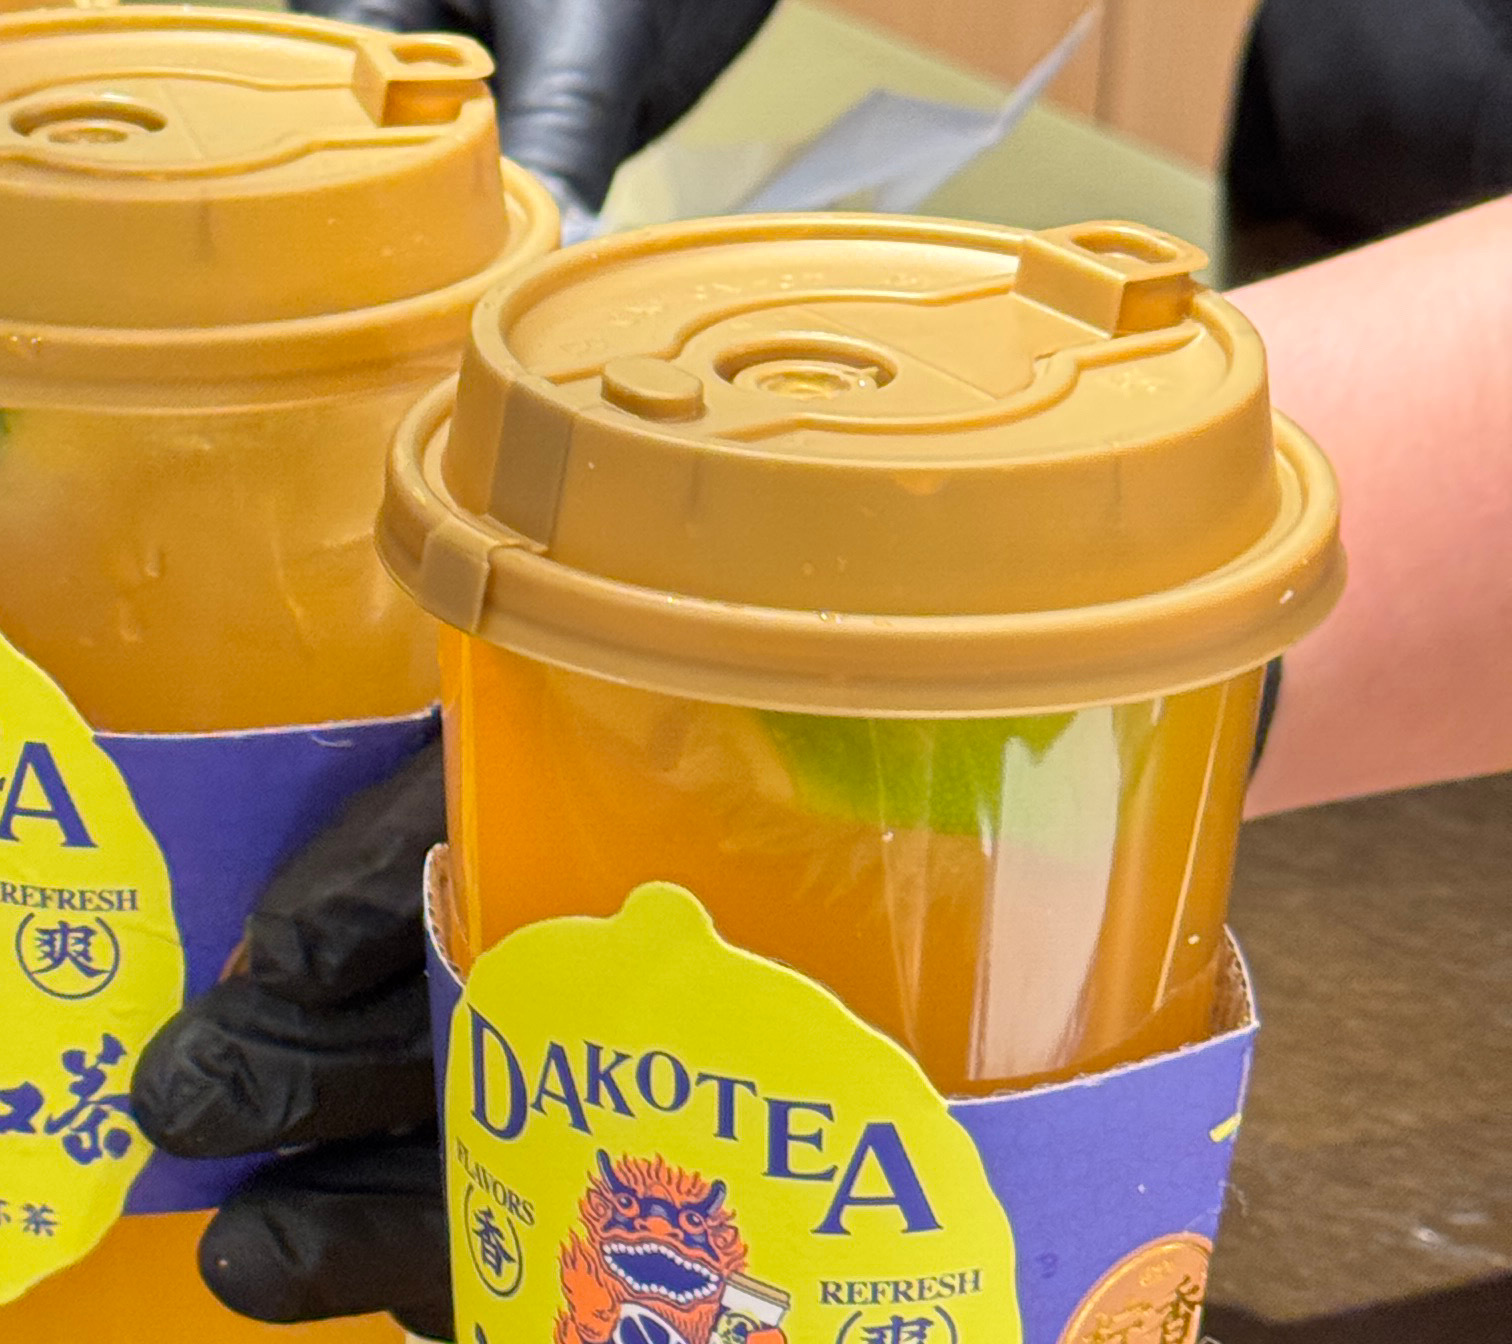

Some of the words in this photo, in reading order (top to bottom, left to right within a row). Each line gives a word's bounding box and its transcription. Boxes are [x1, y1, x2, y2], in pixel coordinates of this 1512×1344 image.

[0, 881, 139, 913] REFRESH
[30, 920, 113, 978] 爽
[468, 1002, 944, 1235] DAKOTEA
[457, 1136, 536, 1227] FLAVORS
[472, 1206, 516, 1277] 香
[820, 1269, 982, 1305] REFRESH
